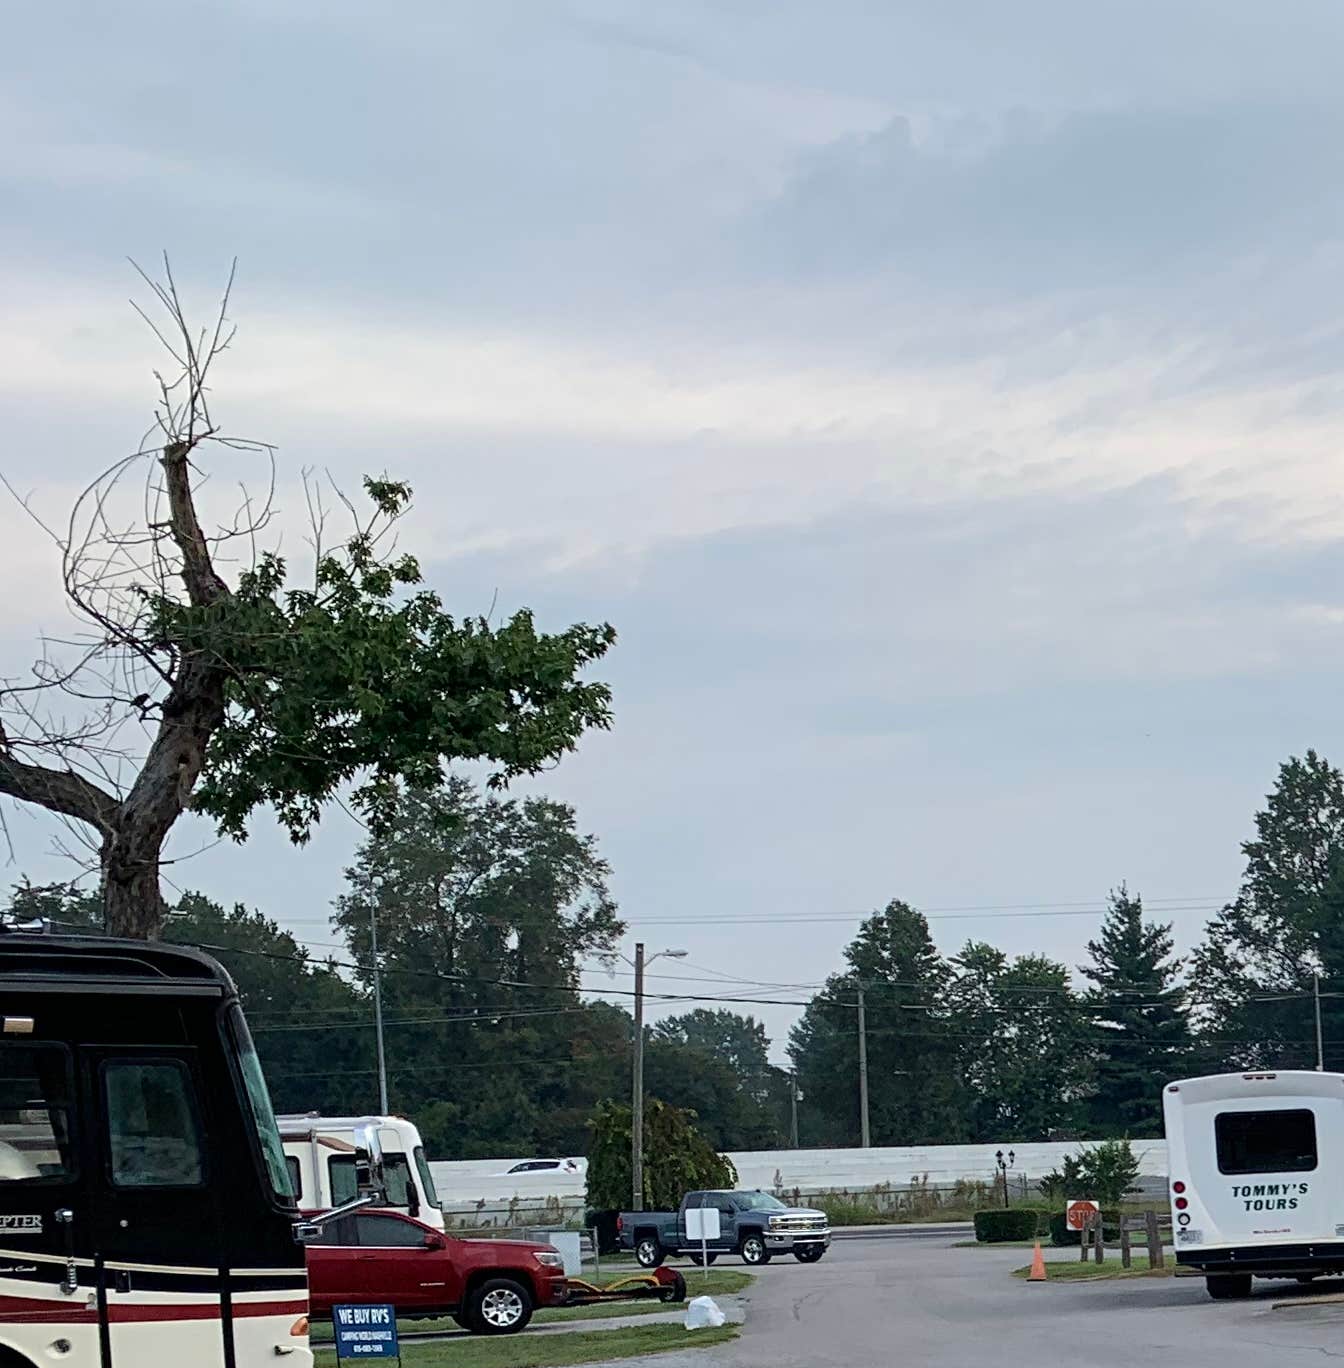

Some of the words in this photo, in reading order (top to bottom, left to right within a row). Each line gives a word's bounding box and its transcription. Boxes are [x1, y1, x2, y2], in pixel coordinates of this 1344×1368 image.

[1231, 1182, 1309, 1198] TOMMY'S
[1243, 1197, 1299, 1212] TOURS
[338, 1308, 354, 1325] WE
[354, 1308, 370, 1325] BUY
[371, 1308, 390, 1325] RV'S
